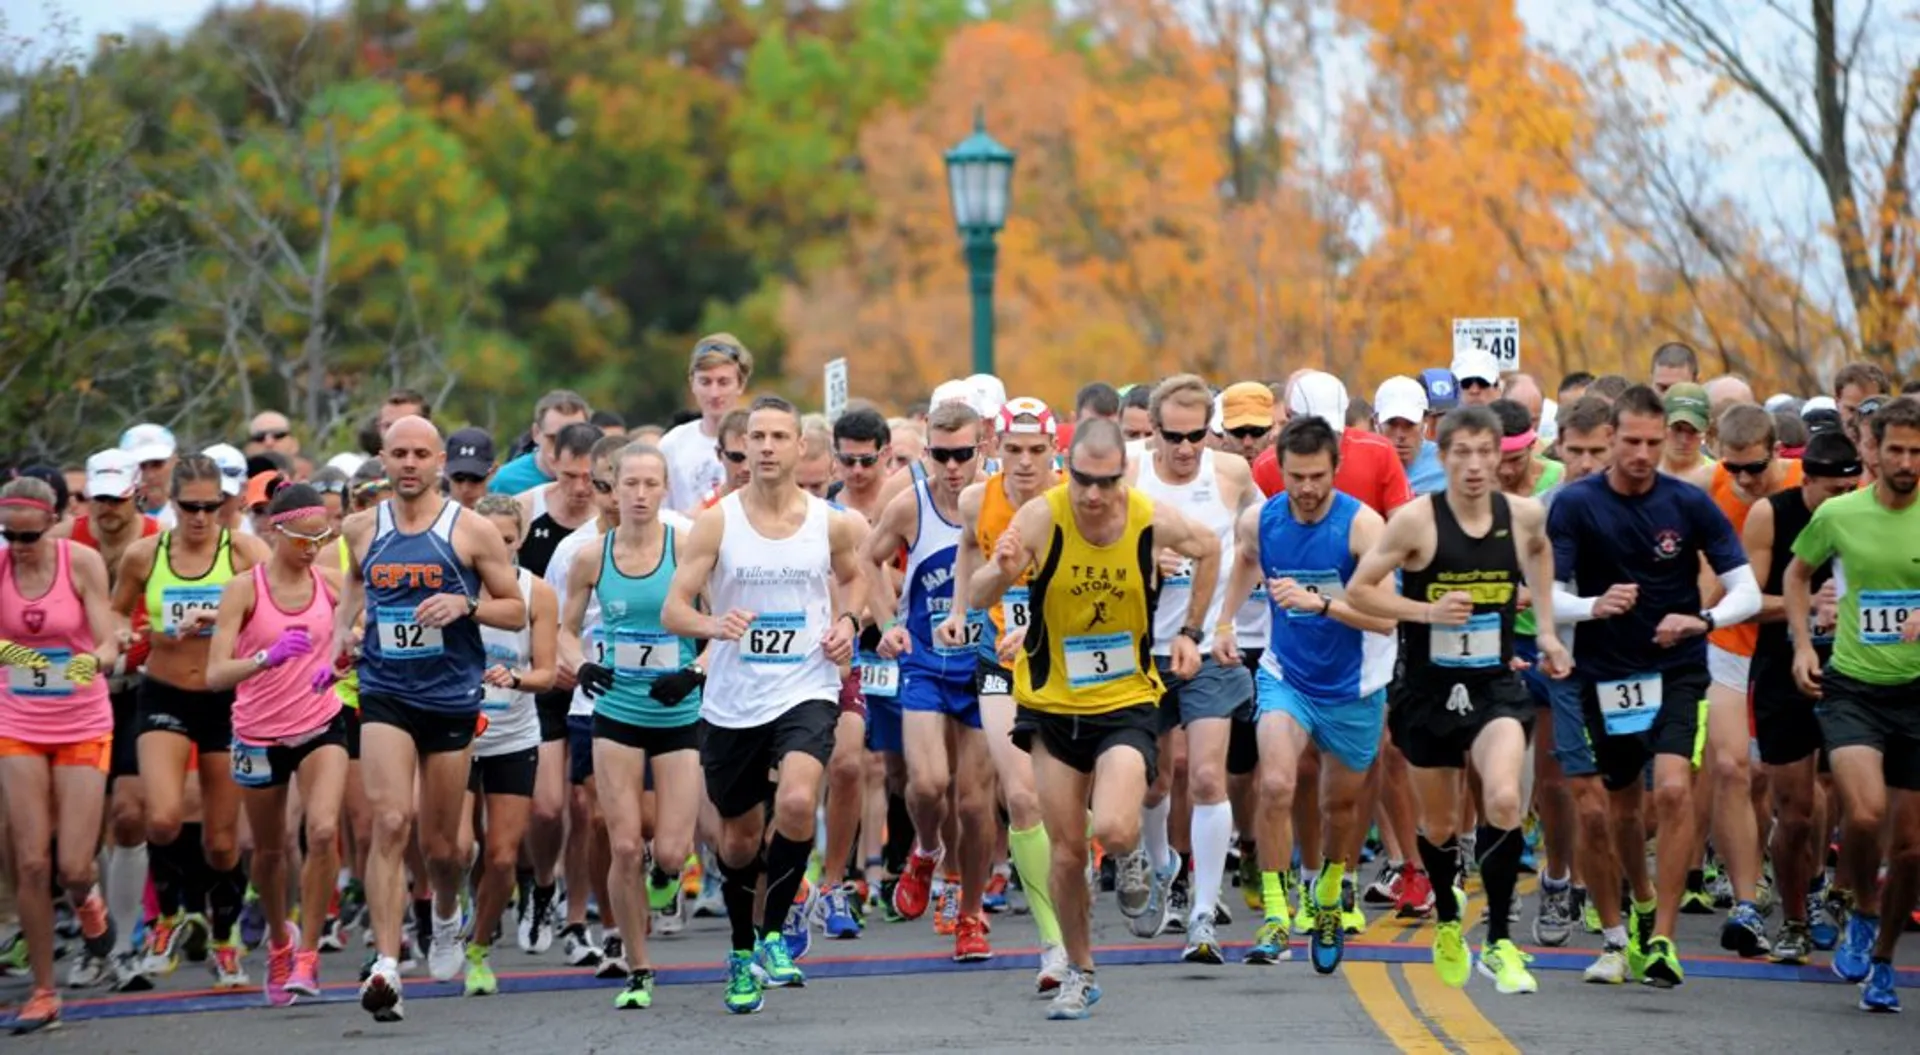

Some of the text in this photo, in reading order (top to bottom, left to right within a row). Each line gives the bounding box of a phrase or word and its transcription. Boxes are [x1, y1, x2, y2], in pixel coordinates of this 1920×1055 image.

[371, 563, 443, 590] CPTC
[1071, 565, 1127, 581] TEAM
[1070, 580, 1126, 600] UTOPIA
[394, 623, 424, 648] 92
[750, 629, 796, 654] 627
[1460, 633, 1472, 656] 1
[640, 645, 653, 666] 7
[1093, 651, 1109, 674] 3
[33, 668, 47, 687] 5
[1616, 683, 1645, 709] 31
